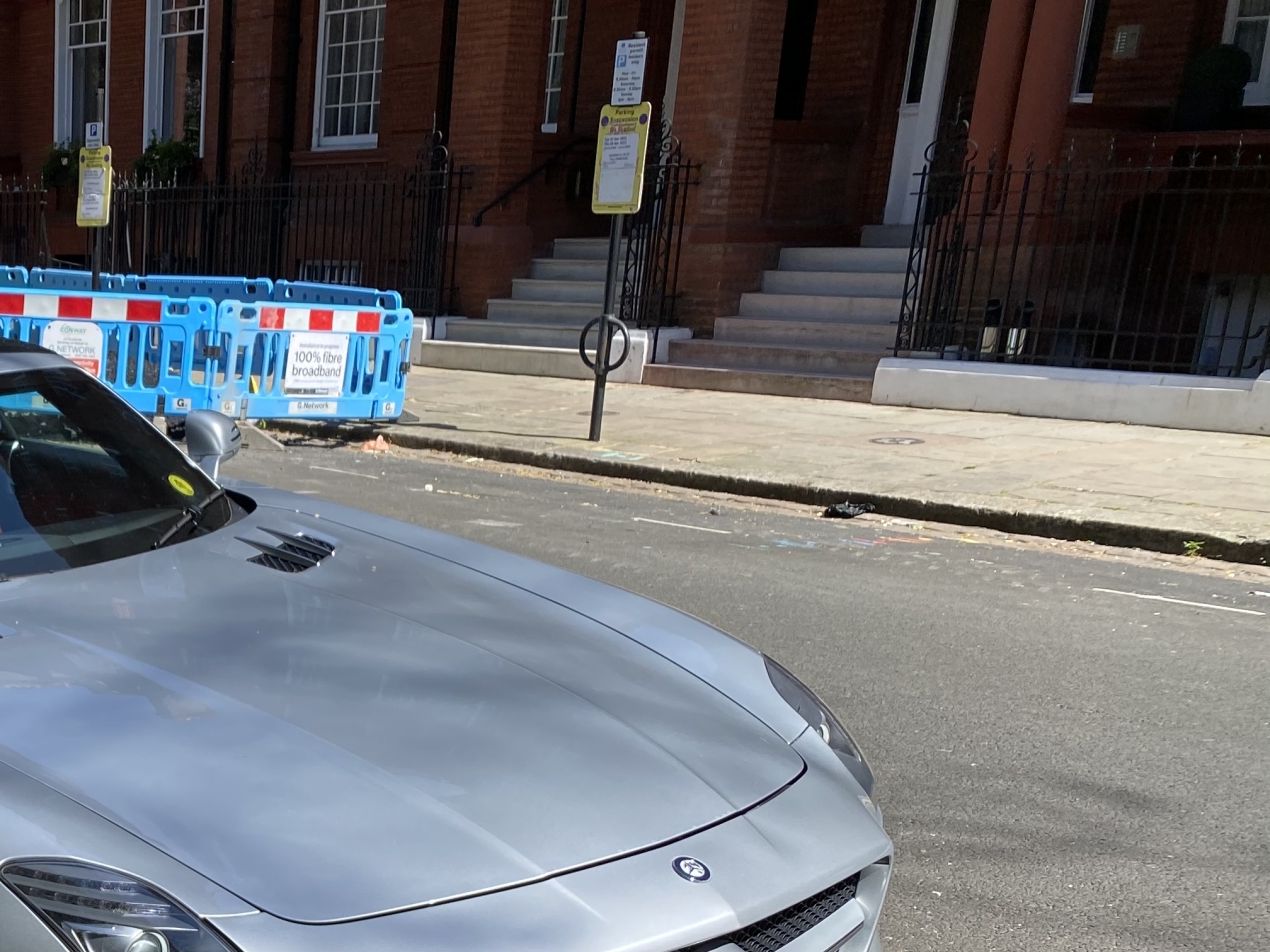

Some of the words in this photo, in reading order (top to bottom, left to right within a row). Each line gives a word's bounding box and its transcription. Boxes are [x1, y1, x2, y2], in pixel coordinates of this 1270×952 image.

[57, 346, 96, 354] NETWORK
[294, 350, 322, 364] 100%
[323, 350, 343, 364] fibre
[291, 364, 342, 378] broadband
